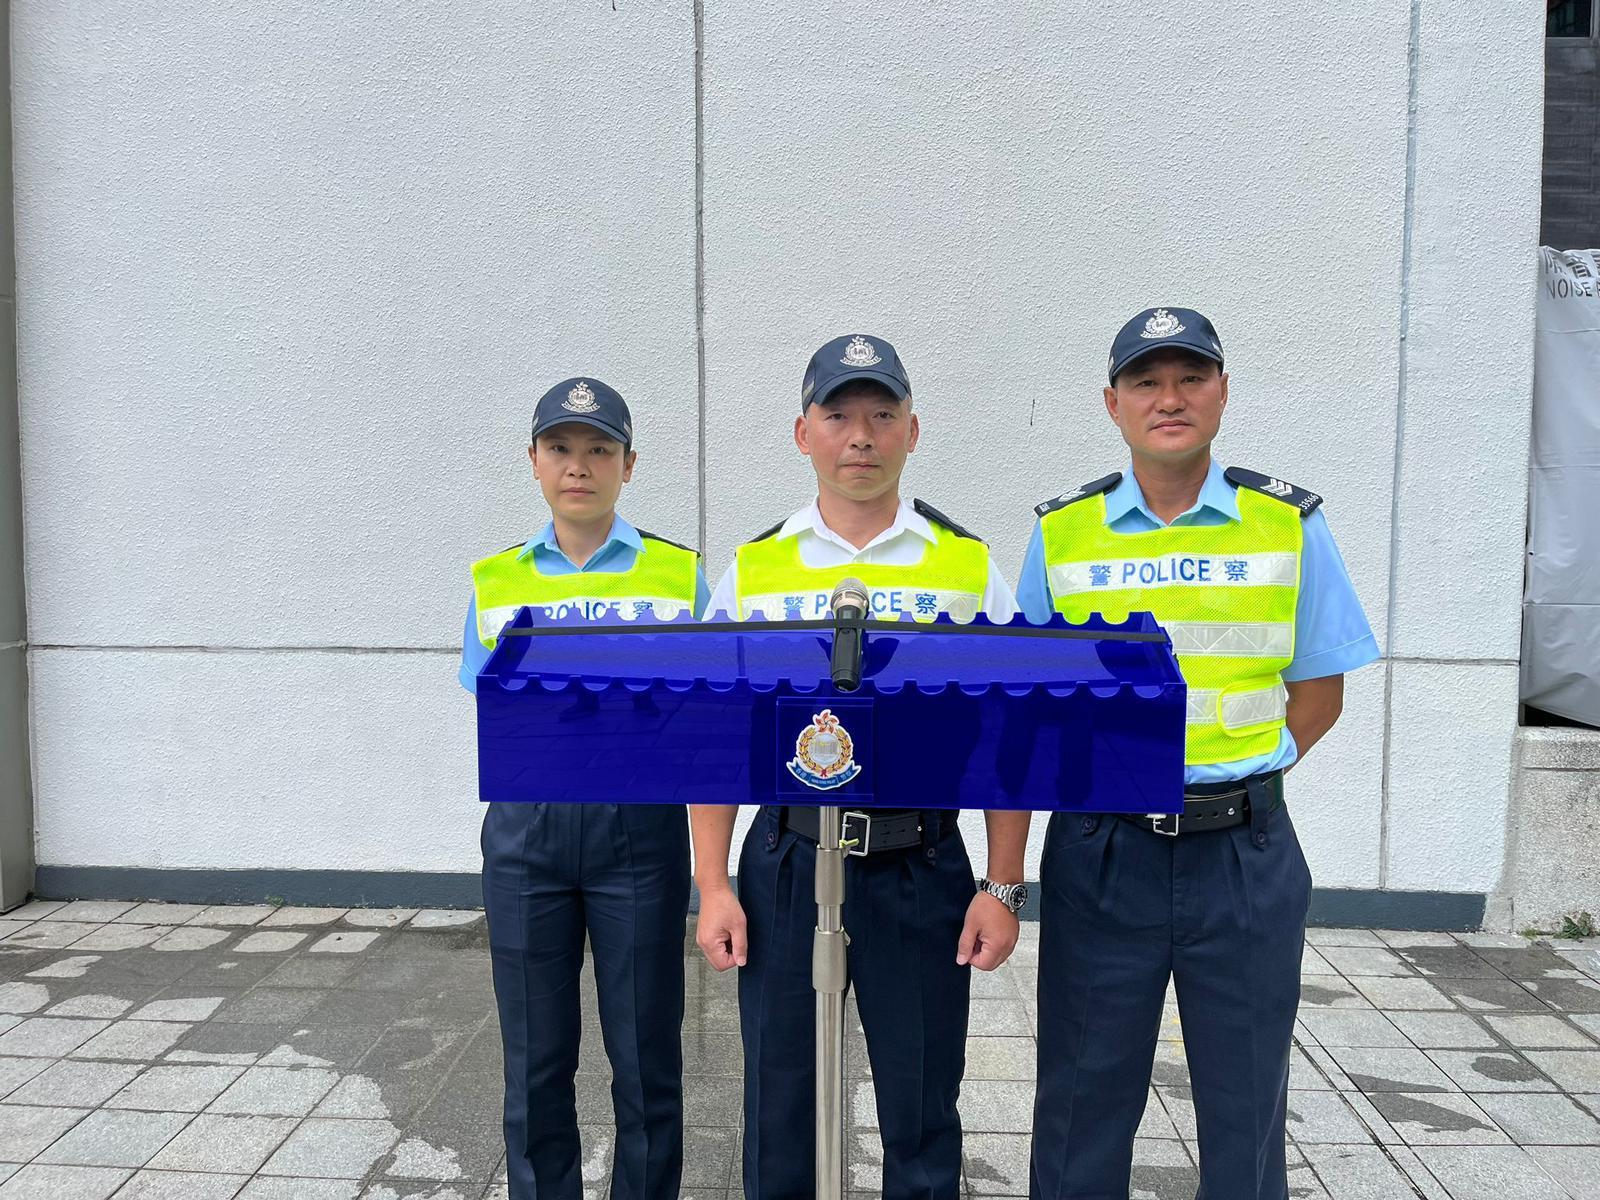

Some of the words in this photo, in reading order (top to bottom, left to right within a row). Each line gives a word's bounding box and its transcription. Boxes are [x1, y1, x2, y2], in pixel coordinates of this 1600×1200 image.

[1546, 279, 1592, 299] NOISE
[1089, 565, 1112, 586] 警
[1122, 558, 1212, 584] POLICE
[1224, 560, 1248, 581] 察
[544, 602, 621, 620] POIC
[815, 592, 902, 615] PCE
[915, 593, 937, 614] 察
